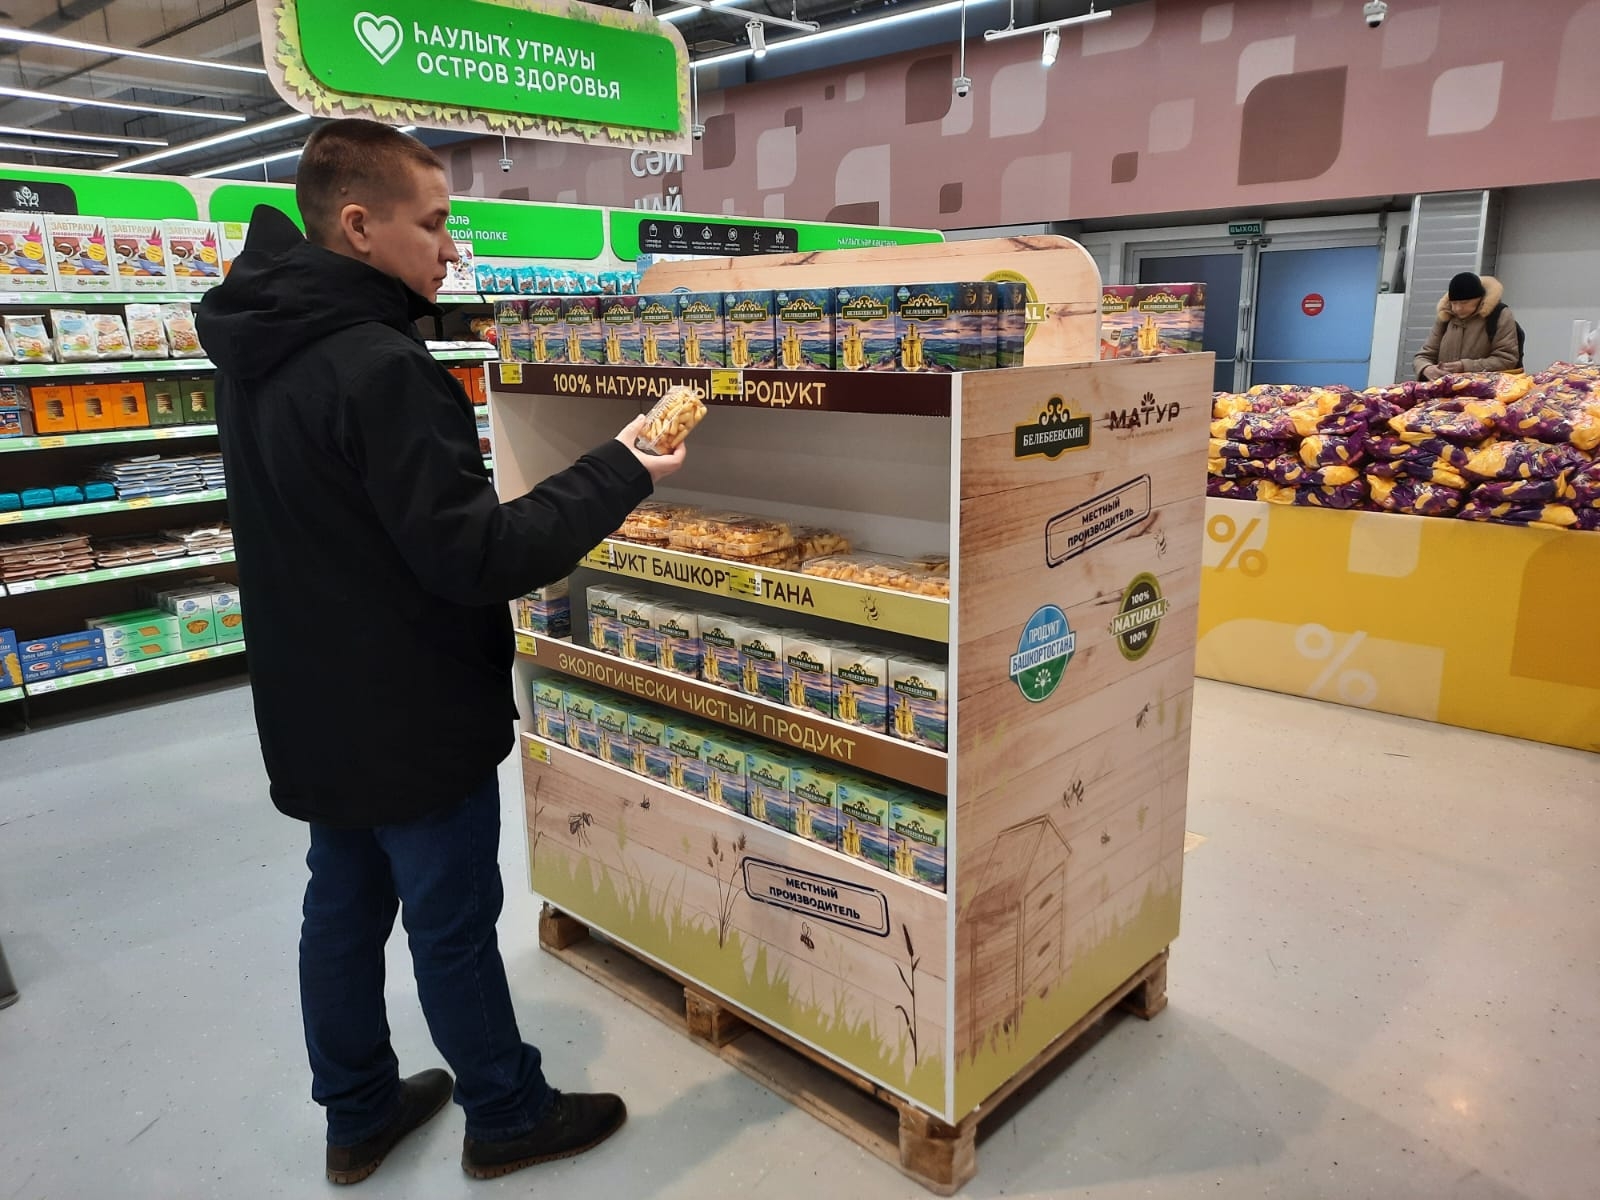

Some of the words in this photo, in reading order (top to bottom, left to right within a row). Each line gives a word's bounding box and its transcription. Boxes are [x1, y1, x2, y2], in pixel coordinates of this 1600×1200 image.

[517, 39, 596, 71] УТРАУЫ
[416, 51, 509, 84] ОСТРОВ
[514, 65, 621, 101] ЗДОРОВЬЯ
[449, 229, 473, 240] ДОЙ
[475, 230, 508, 241] ПОЛКЕ
[553, 373, 591, 394] 100%
[730, 380, 826, 408] РОДУКТ
[1110, 401, 1180, 431] МАТУР
[1023, 425, 1084, 446] БЕЛЕБЕЕВСКИЙ
[1081, 497, 1120, 525] МЕСТНЫЙ
[1067, 508, 1134, 549] ПРОИЗВОДИТЕЛЬ
[585, 549, 647, 574] ДУКТ
[653, 557, 815, 608] БАШКОРТАНА
[1131, 590, 1150, 606] 100%
[1027, 618, 1061, 645] ПРОДУКТ
[1114, 602, 1163, 634] NATURAL
[1129, 629, 1148, 645] 100%
[1012, 636, 1074, 673] БАШКОРТОСТАНА
[558, 652, 678, 702] ЭКОЛОГИЧЕСКИ
[683, 691, 757, 730] ЧИСТЫЙ
[763, 714, 856, 759] ПРОДУКТ
[769, 886, 861, 920] ПРОИЗВОДИТЕЛЬ
[785, 876, 839, 899] МЕСТНЫЙ
